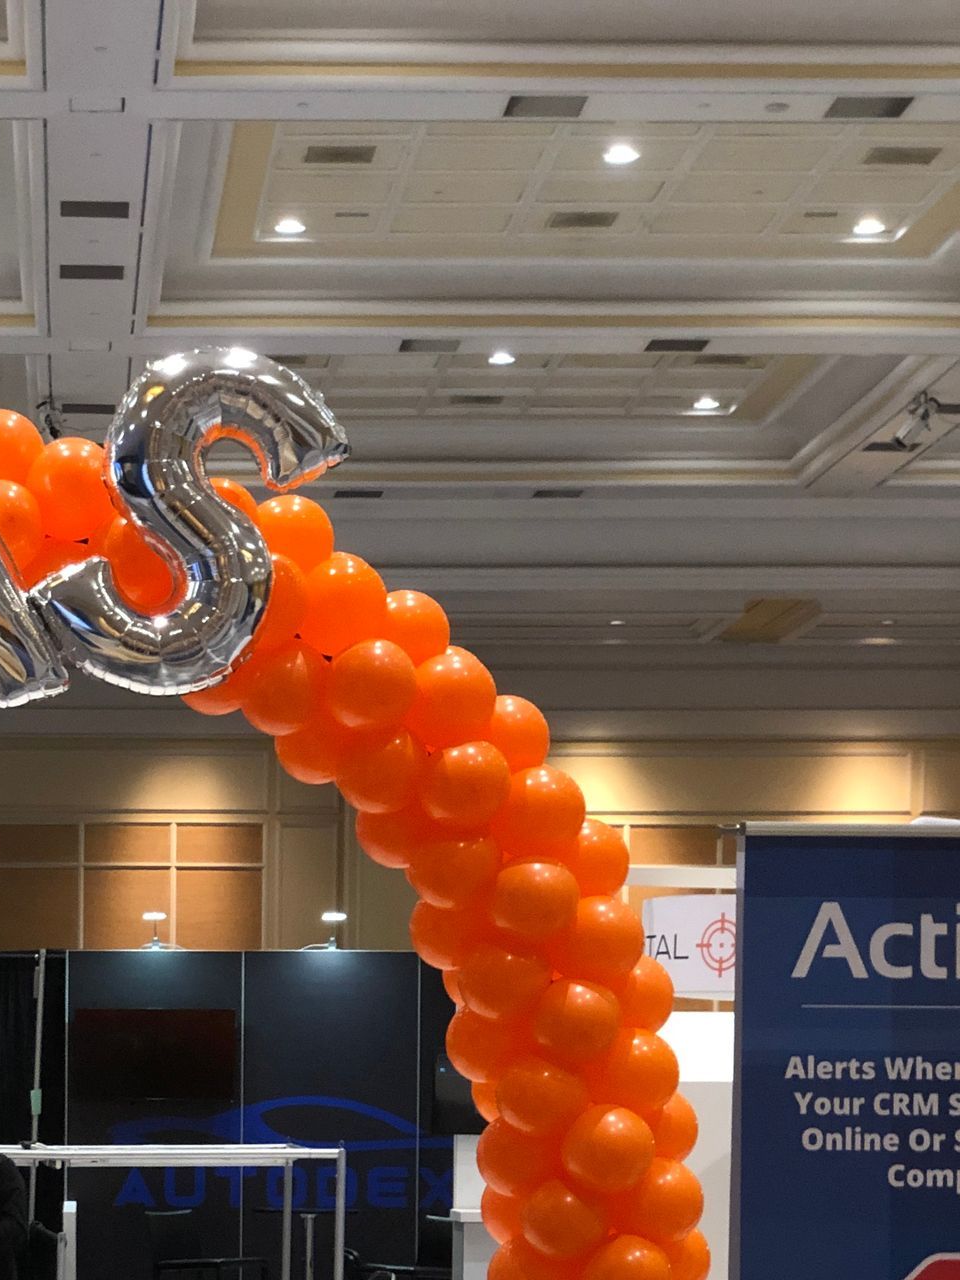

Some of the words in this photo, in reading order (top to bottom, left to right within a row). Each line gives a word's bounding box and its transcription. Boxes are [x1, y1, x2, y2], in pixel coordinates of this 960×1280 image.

[645, 933, 689, 960] TAL
[791, 901, 960, 979] Act
[784, 1055, 876, 1080] Alerts
[794, 1091, 865, 1116] Your
[873, 1092, 939, 1116] CRM
[801, 1126, 900, 1151] Online
[908, 1127, 946, 1152] Or
[113, 1165, 454, 1210] AUTODEX
[887, 1164, 960, 1194] Com
